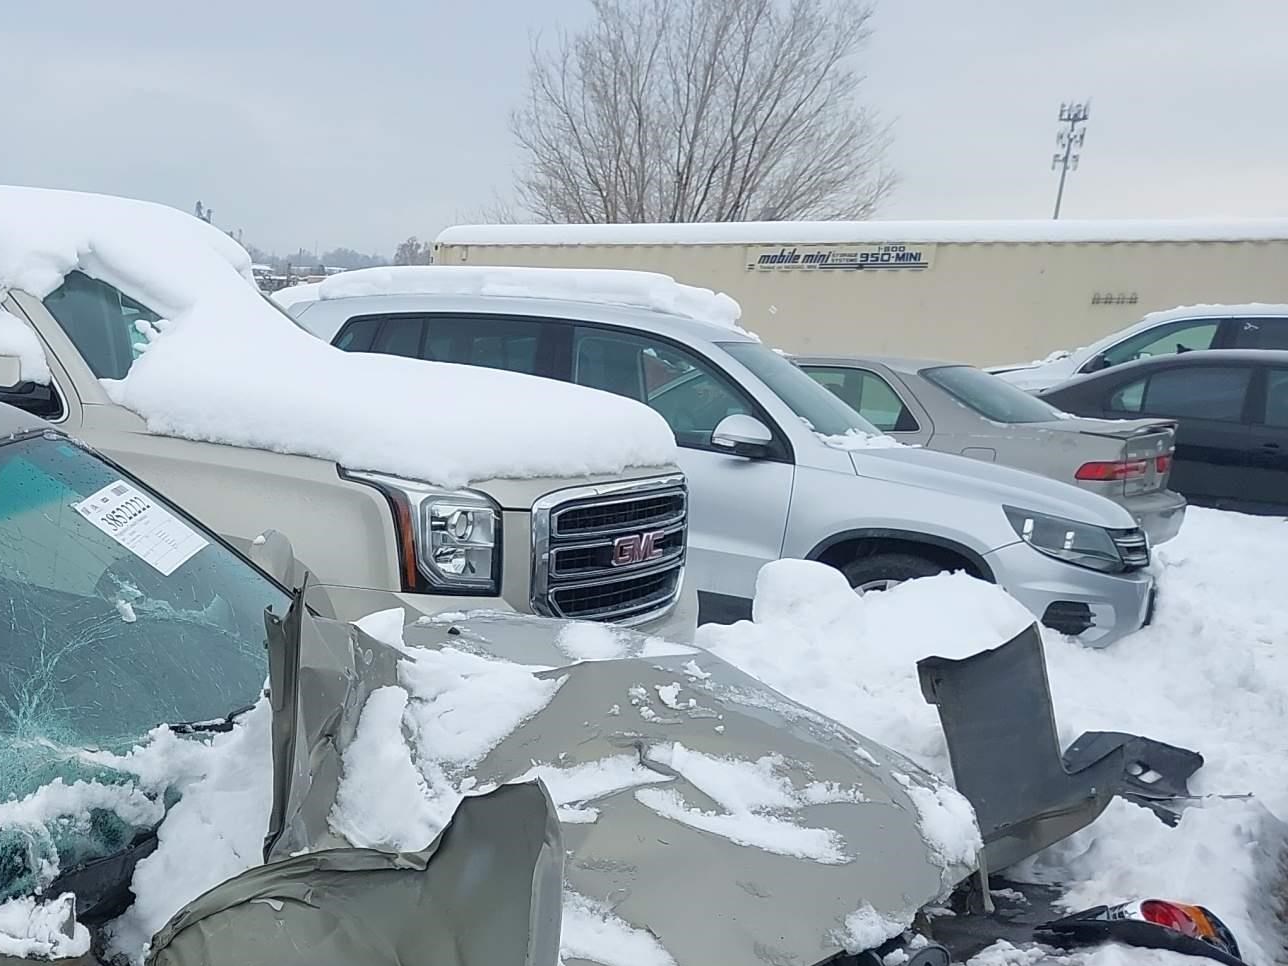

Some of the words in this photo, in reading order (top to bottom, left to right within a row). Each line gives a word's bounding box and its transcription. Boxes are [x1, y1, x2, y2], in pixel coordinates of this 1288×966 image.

[758, 248, 800, 264] mobile
[801, 251, 832, 264] mini
[100, 496, 152, 532] 38522222
[611, 530, 665, 566] GMC
